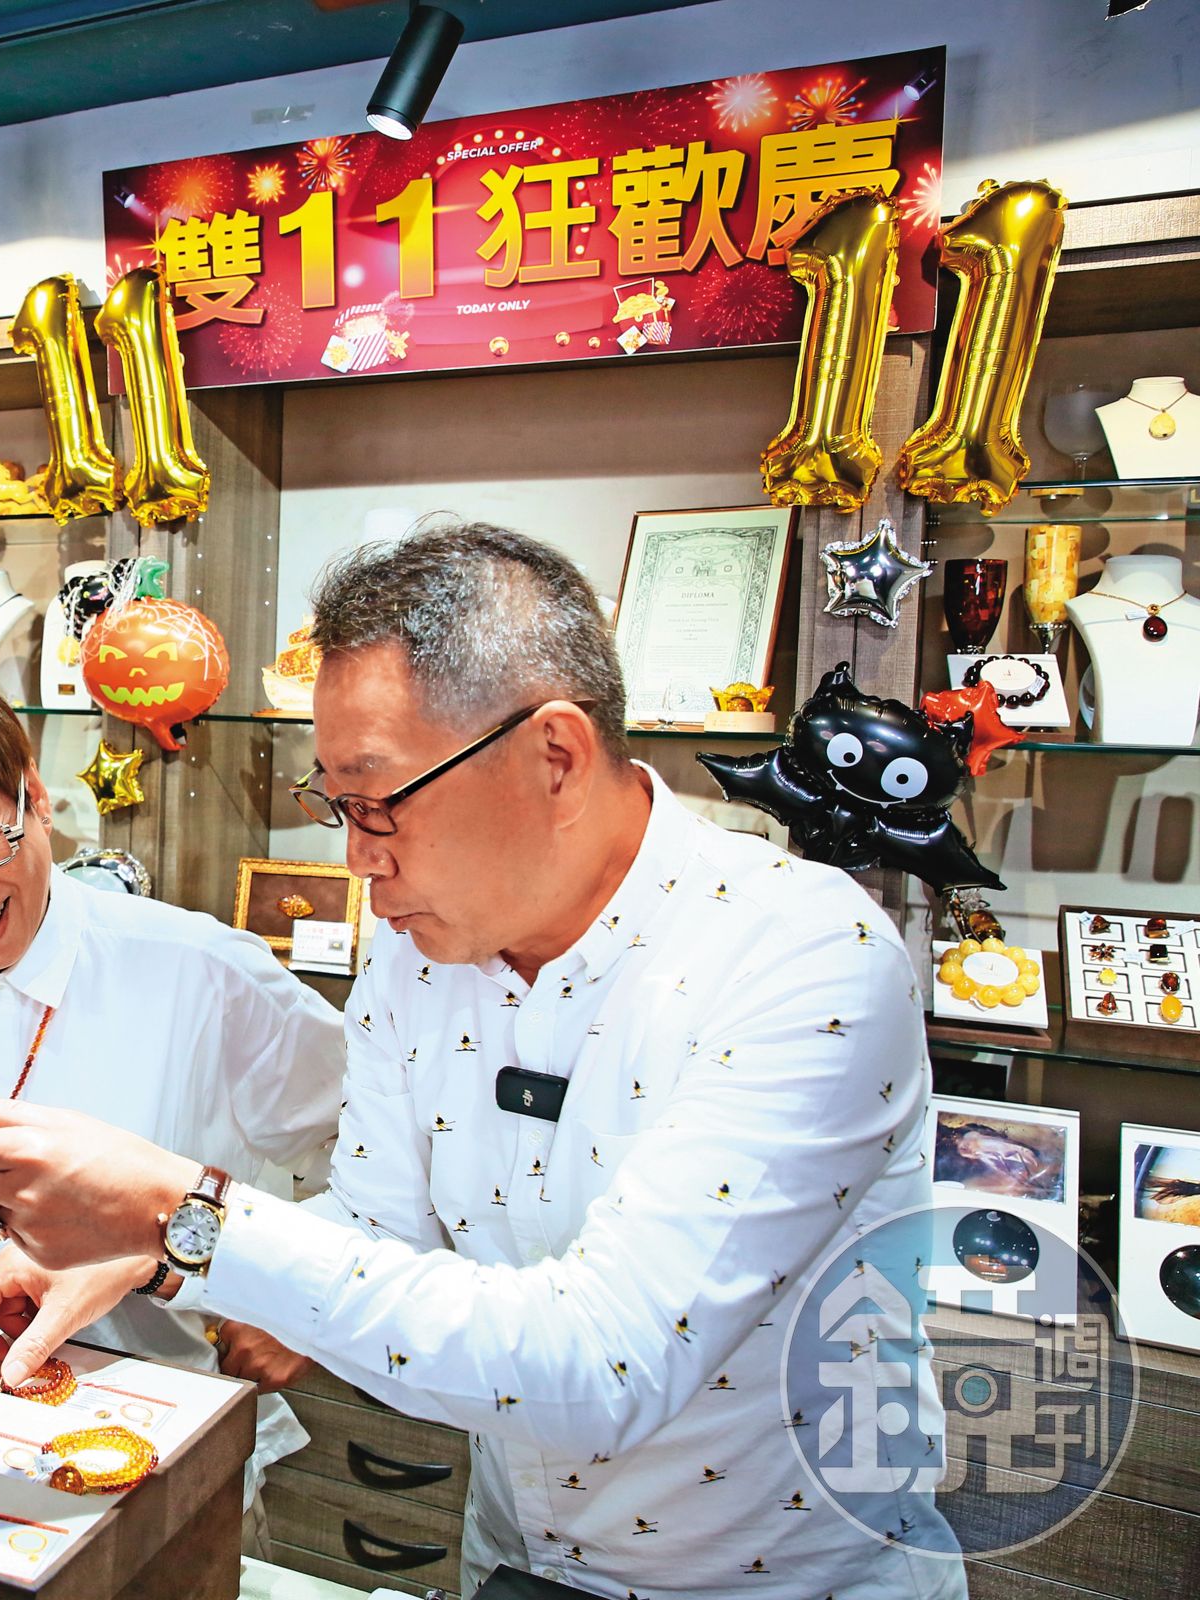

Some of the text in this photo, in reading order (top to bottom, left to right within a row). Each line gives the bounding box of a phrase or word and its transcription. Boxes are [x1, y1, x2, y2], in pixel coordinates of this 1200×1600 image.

[446, 140, 540, 161] SPECIAL OFFER
[456, 299, 531, 315] TODAY ONLY
